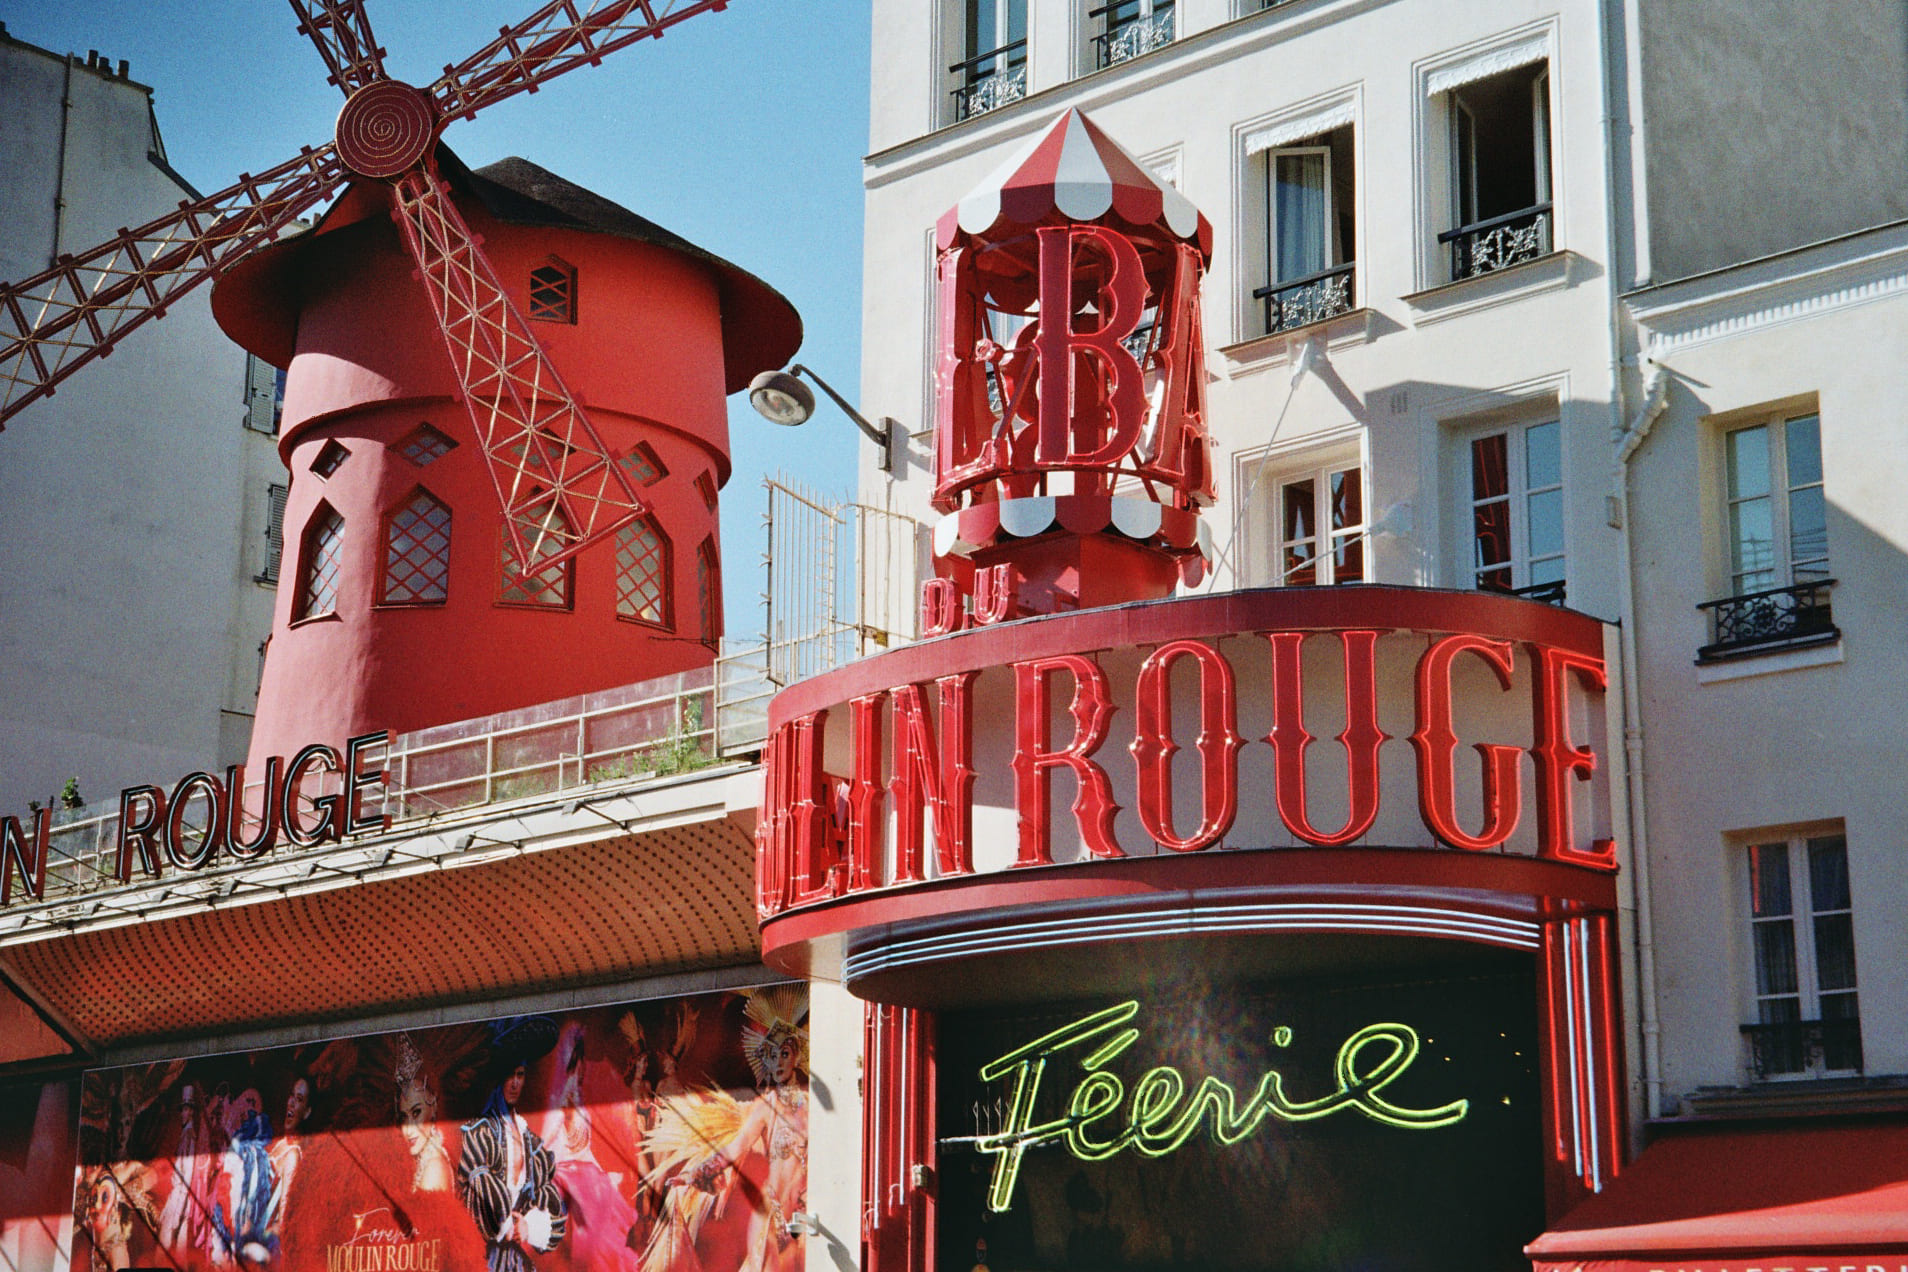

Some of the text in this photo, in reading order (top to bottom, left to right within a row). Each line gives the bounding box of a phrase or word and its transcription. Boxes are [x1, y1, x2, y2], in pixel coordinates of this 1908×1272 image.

[920, 562, 1016, 639] DU
[115, 729, 398, 884] ROUGE
[1008, 629, 1620, 873] ROUGE
[980, 1000, 1469, 1212] Féerie
[326, 1238, 441, 1272] MOULIN ROUGE
